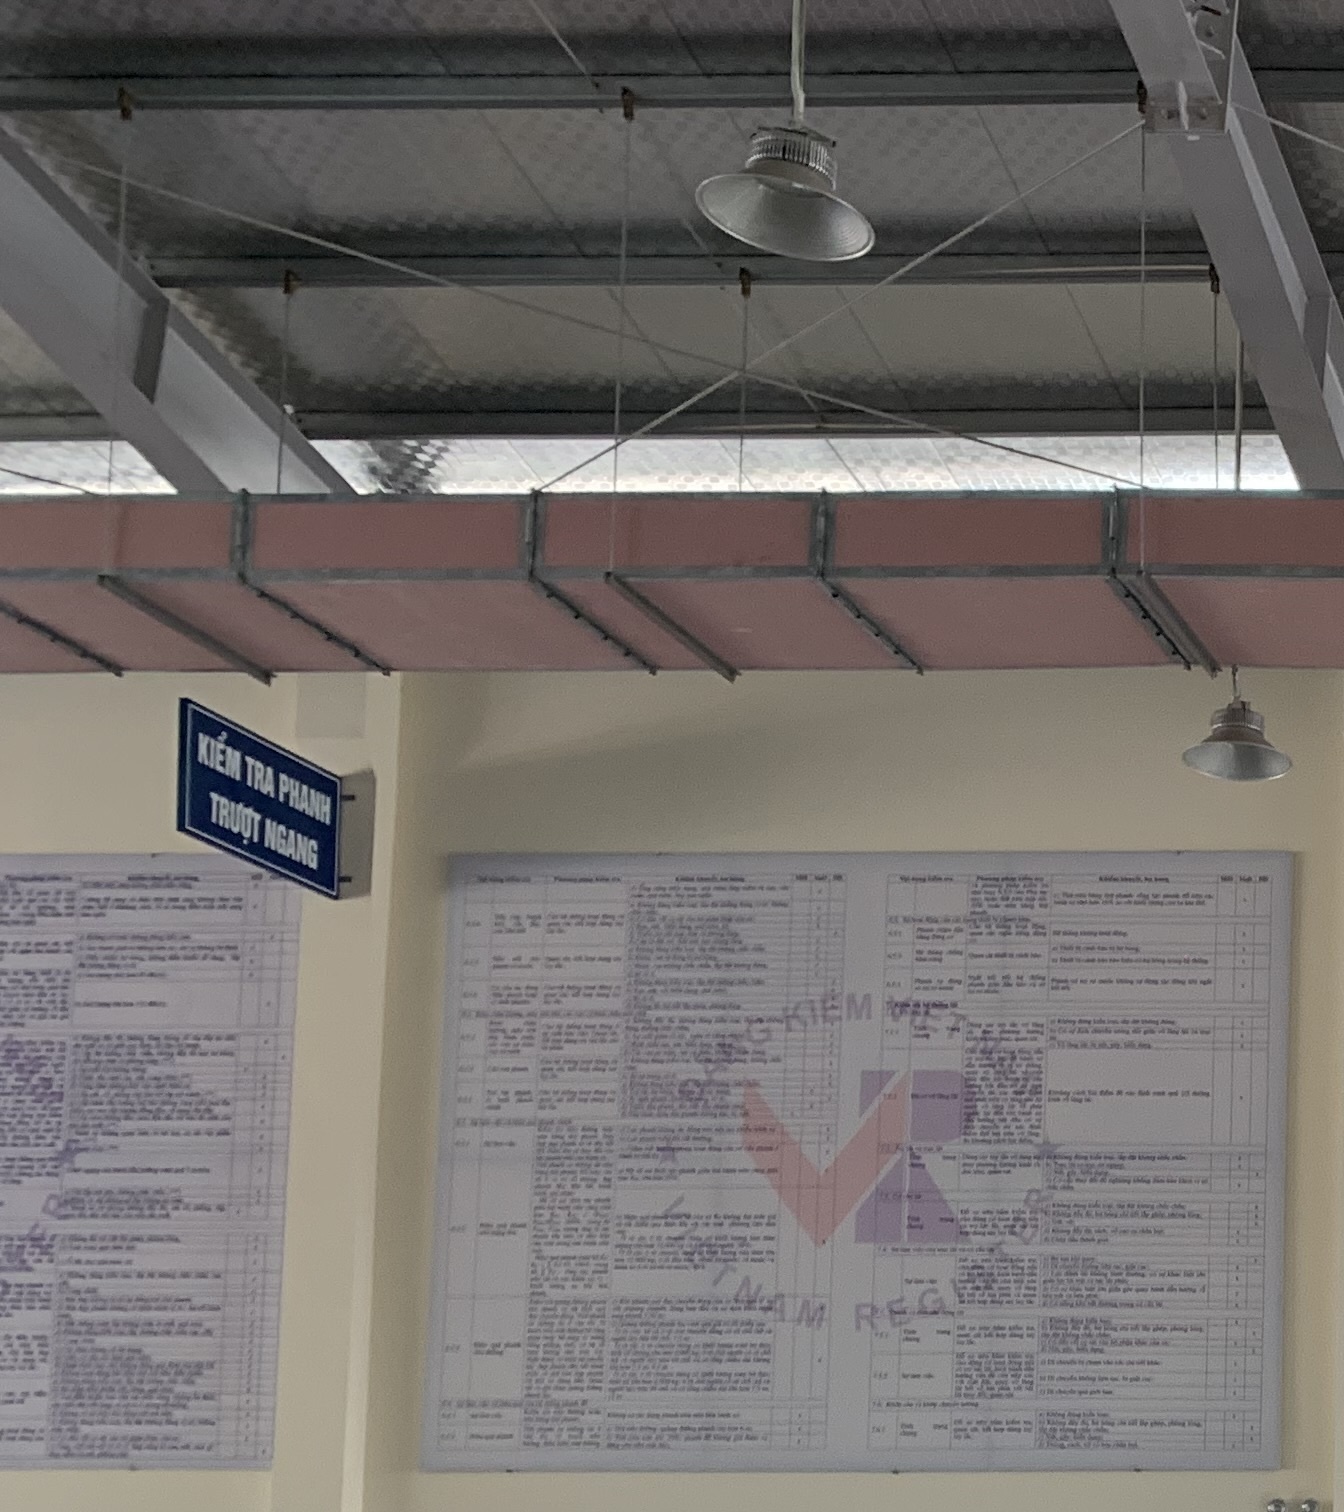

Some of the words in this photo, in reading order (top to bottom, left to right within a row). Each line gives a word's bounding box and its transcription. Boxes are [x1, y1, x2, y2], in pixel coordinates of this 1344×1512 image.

[198, 731, 241, 781] KIỂM
[244, 755, 275, 798] TRA
[278, 772, 331, 826] PHANH
[208, 791, 262, 845] TRƯỢT
[263, 817, 319, 871] NGANG
